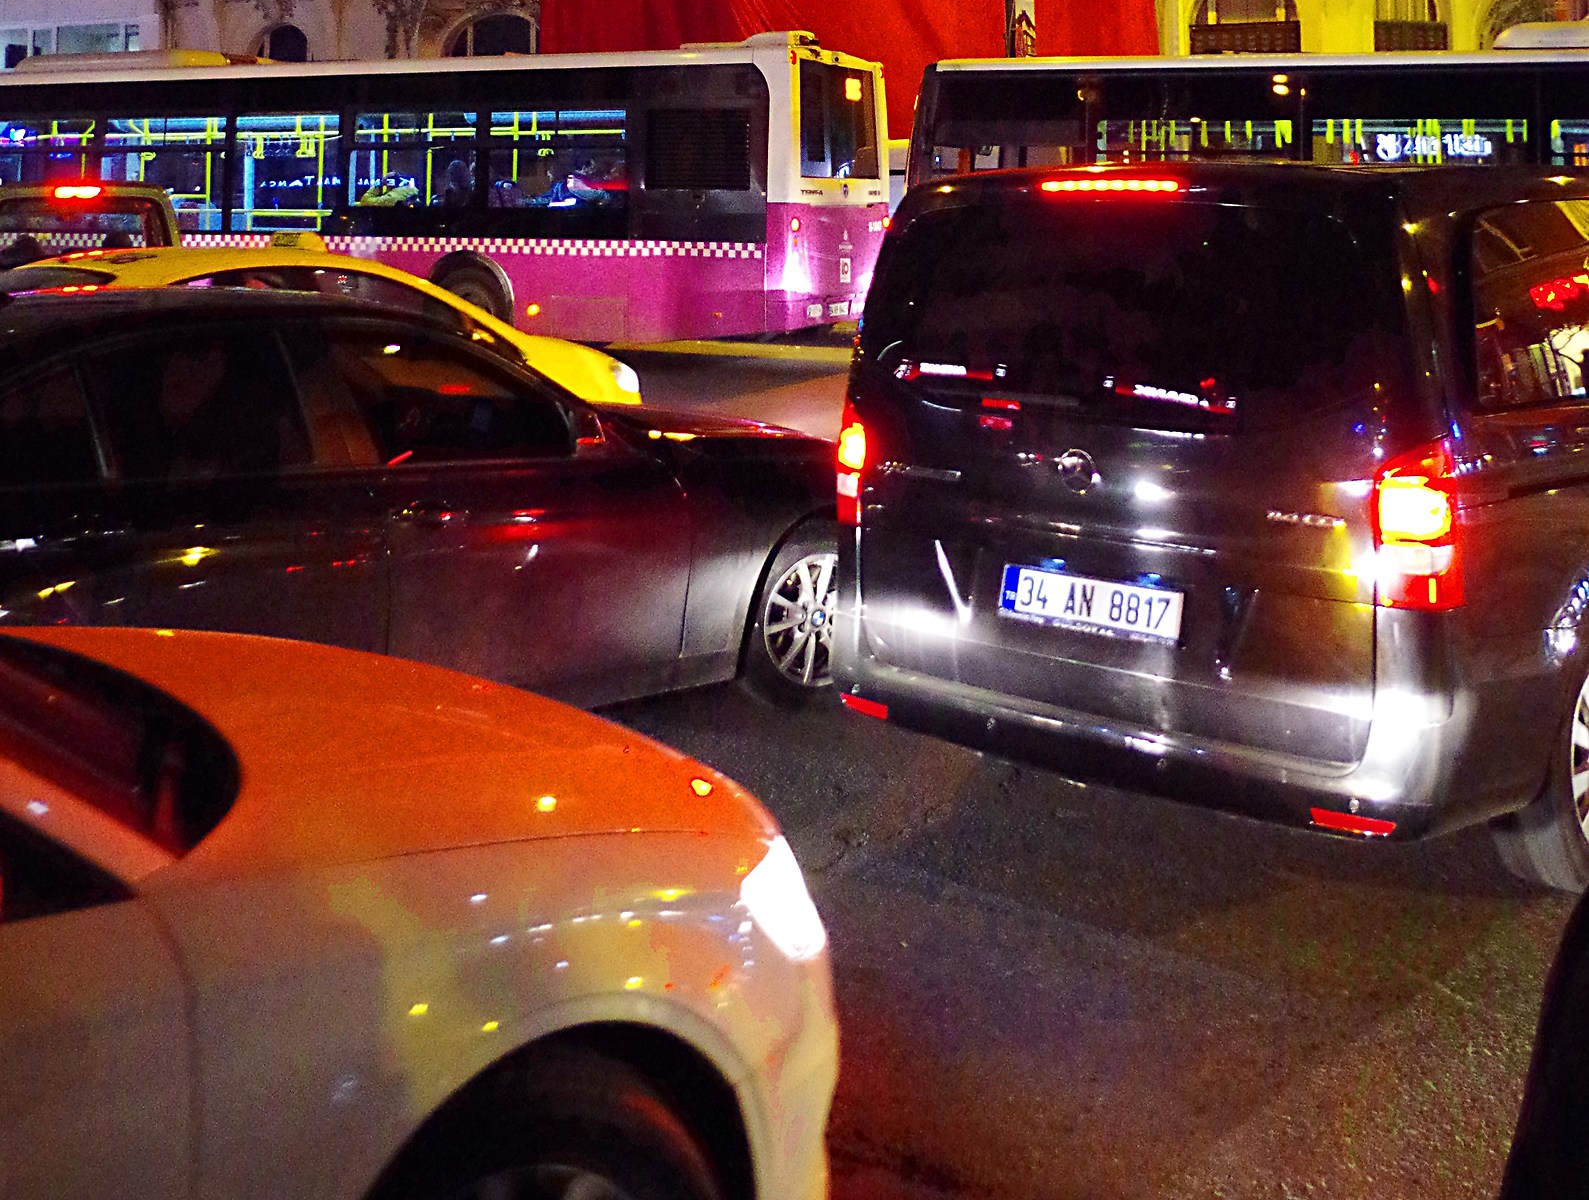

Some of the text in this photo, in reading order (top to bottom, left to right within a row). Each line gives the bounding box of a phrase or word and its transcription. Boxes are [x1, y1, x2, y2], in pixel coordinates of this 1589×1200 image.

[1020, 575, 1048, 609] 34
[1063, 582, 1095, 618] AN
[1109, 590, 1172, 629] 8817
